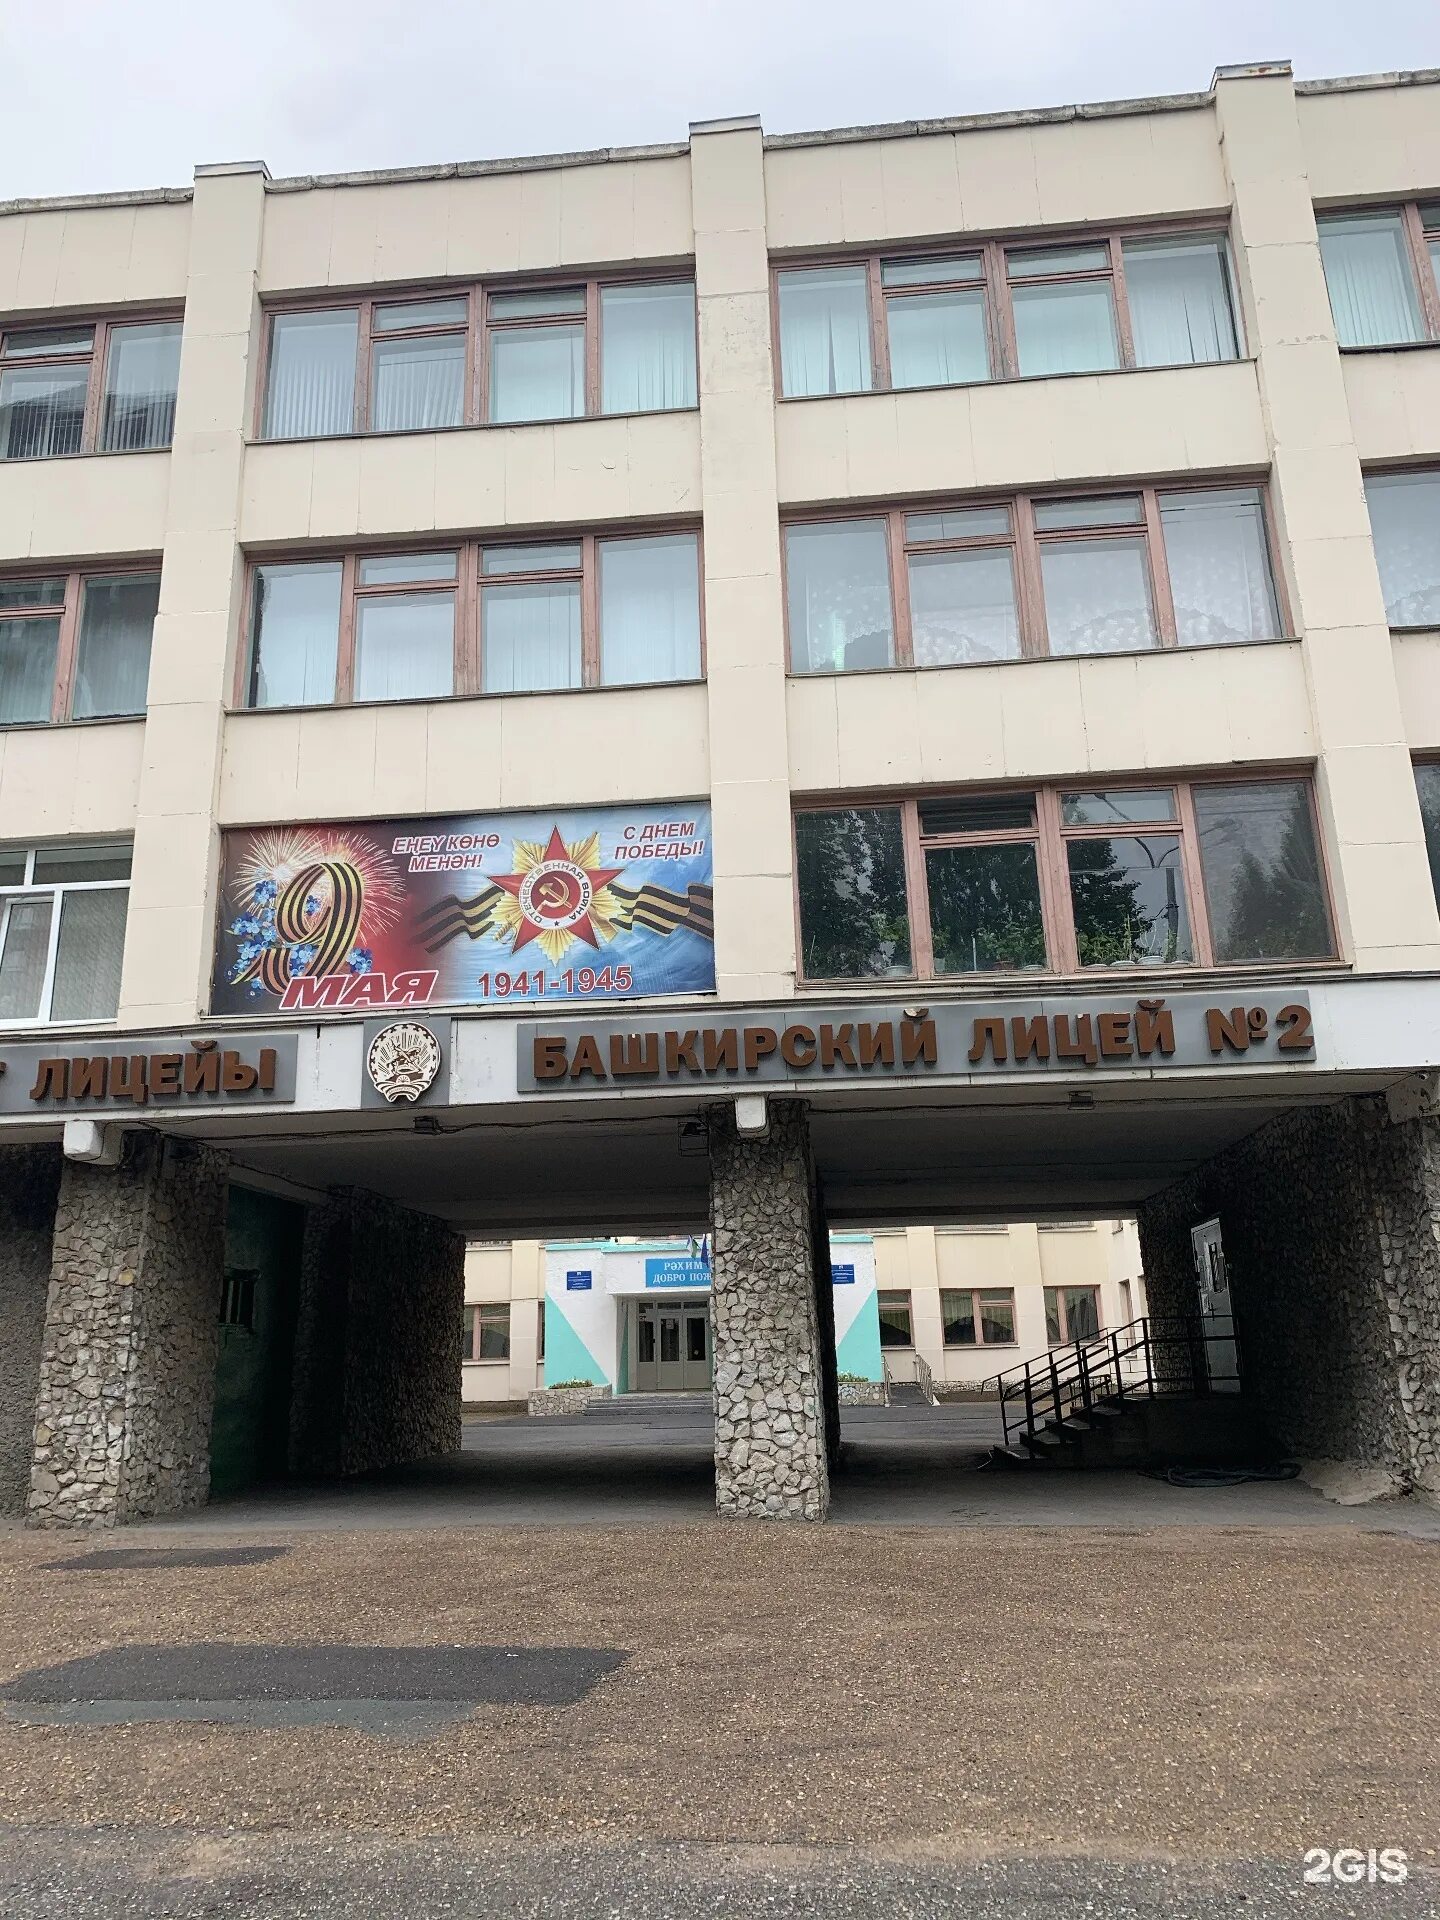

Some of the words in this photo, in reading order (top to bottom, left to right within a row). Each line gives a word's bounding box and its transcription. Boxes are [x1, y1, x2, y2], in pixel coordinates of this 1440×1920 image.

[446, 832, 501, 851] КӨНӨ
[623, 825, 636, 840] С
[640, 822, 695, 842] ДНЕМ
[408, 853, 483, 872] МЕНӘН!
[614, 840, 704, 860] ПОБЕДЫ!
[522, 862, 584, 924] ОТЕЧЕСТВЕННАЯ
[232, 862, 364, 996] 9
[280, 969, 440, 1010] МАЯ
[478, 965, 633, 997] 1941-1945
[533, 1007, 937, 1079] БАШКИРСКИЙ
[967, 1000, 1175, 1065] ЛИЦЕЙ
[1206, 1004, 1313, 1053] №2
[30, 1040, 276, 1103] ЛИЦЕЙЫ
[653, 1273, 686, 1284] ДОБРО
